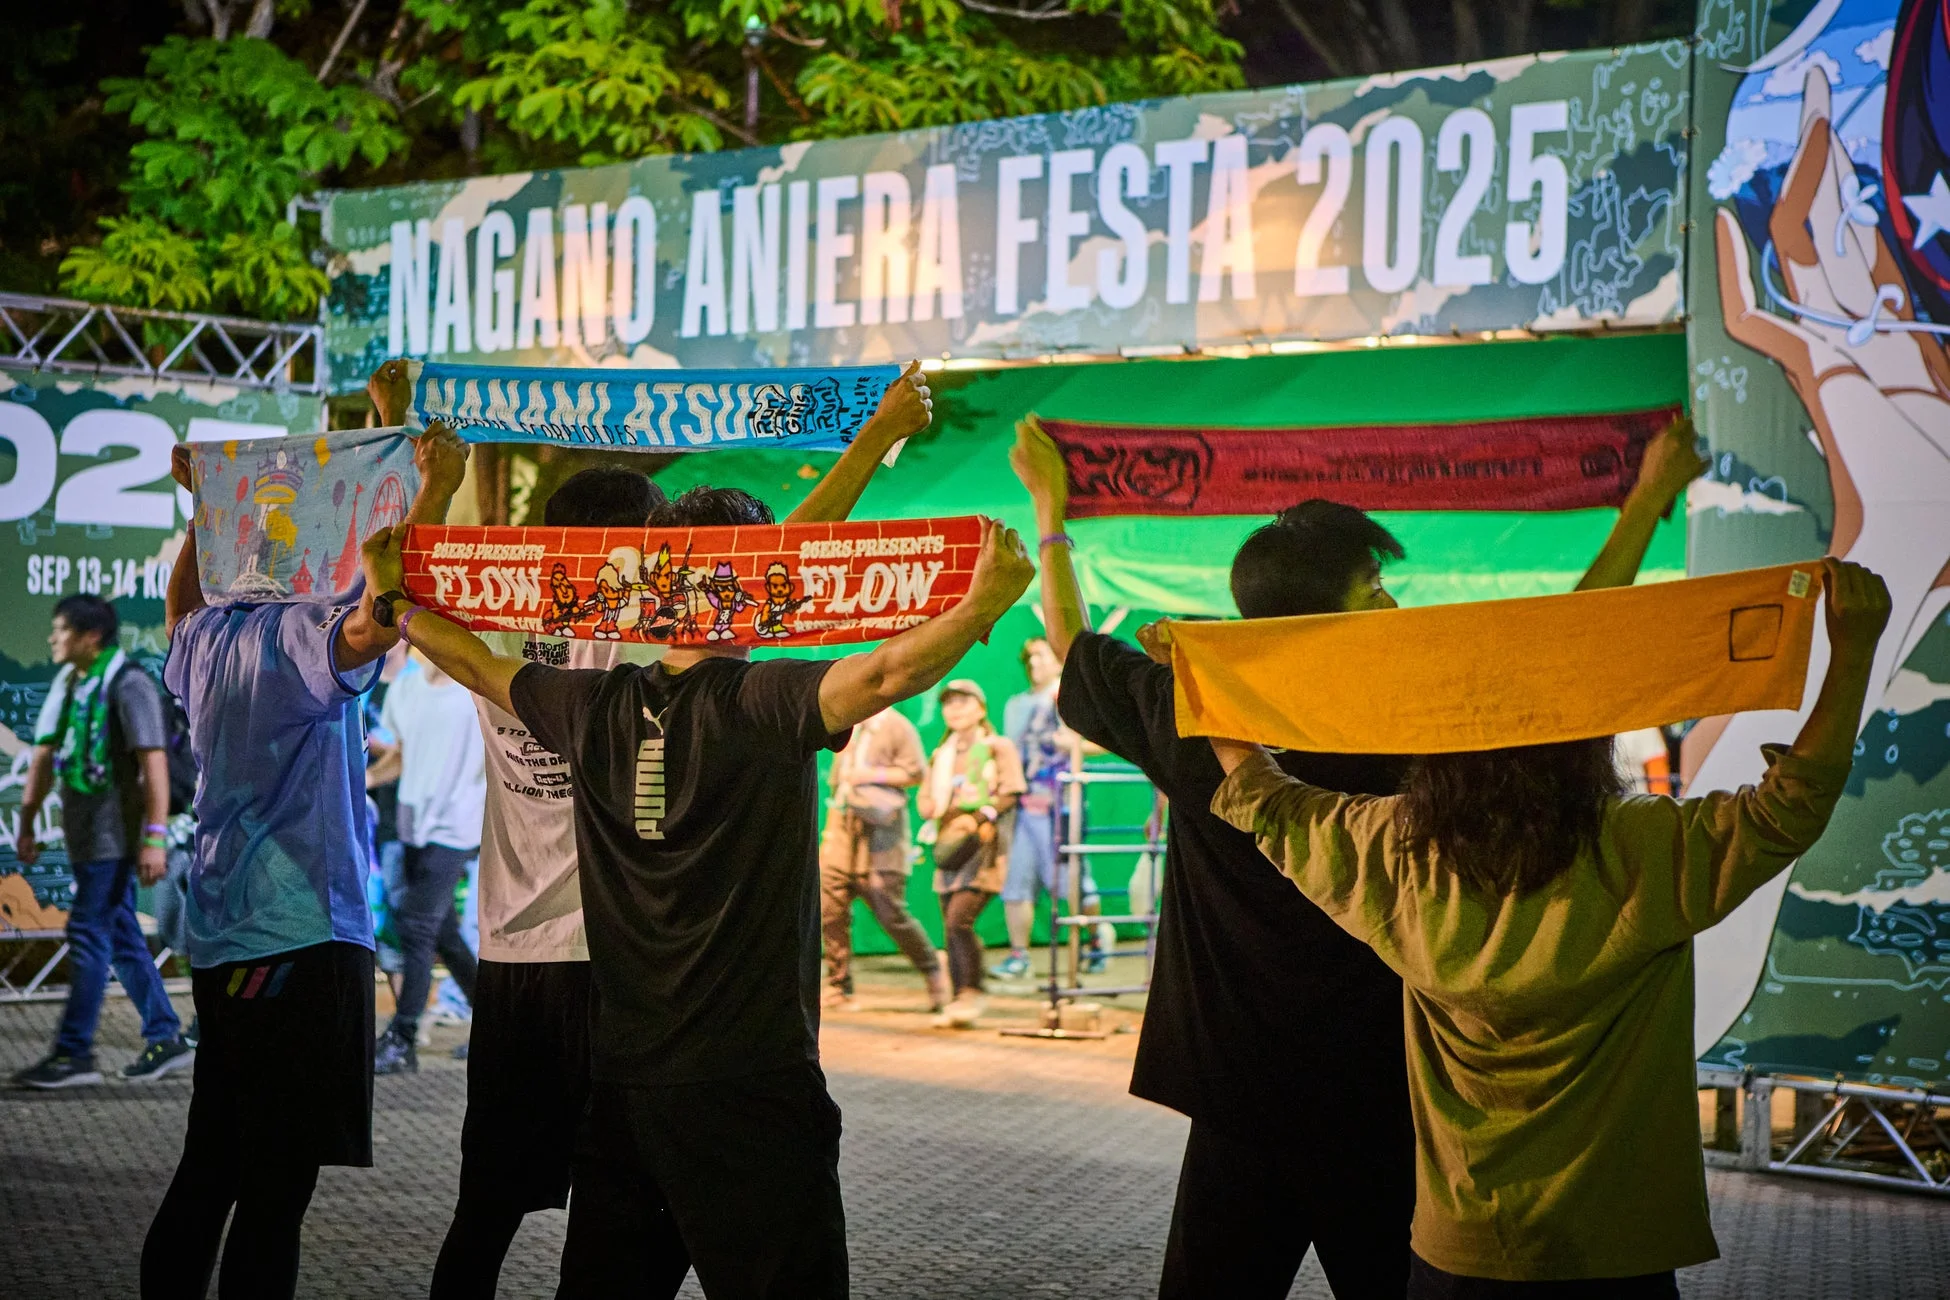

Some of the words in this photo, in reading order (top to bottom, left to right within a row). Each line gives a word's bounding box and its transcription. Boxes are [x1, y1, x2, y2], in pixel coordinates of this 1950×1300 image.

[388, 197, 656, 357] NAGANO
[680, 163, 964, 338] ANIERA
[995, 134, 1257, 315] FESTA
[1294, 100, 1569, 297] 2025
[423, 378, 611, 436] NANAMI
[474, 544, 546, 561] PRESENTS
[855, 535, 945, 558] PRESENTS
[27, 554, 71, 595] SEP
[77, 555, 137, 599] 13-14
[429, 564, 542, 612] FLOW
[796, 561, 944, 614] FLOW
[525, 757, 547, 767] THE
[634, 738, 666, 840] PUMA
